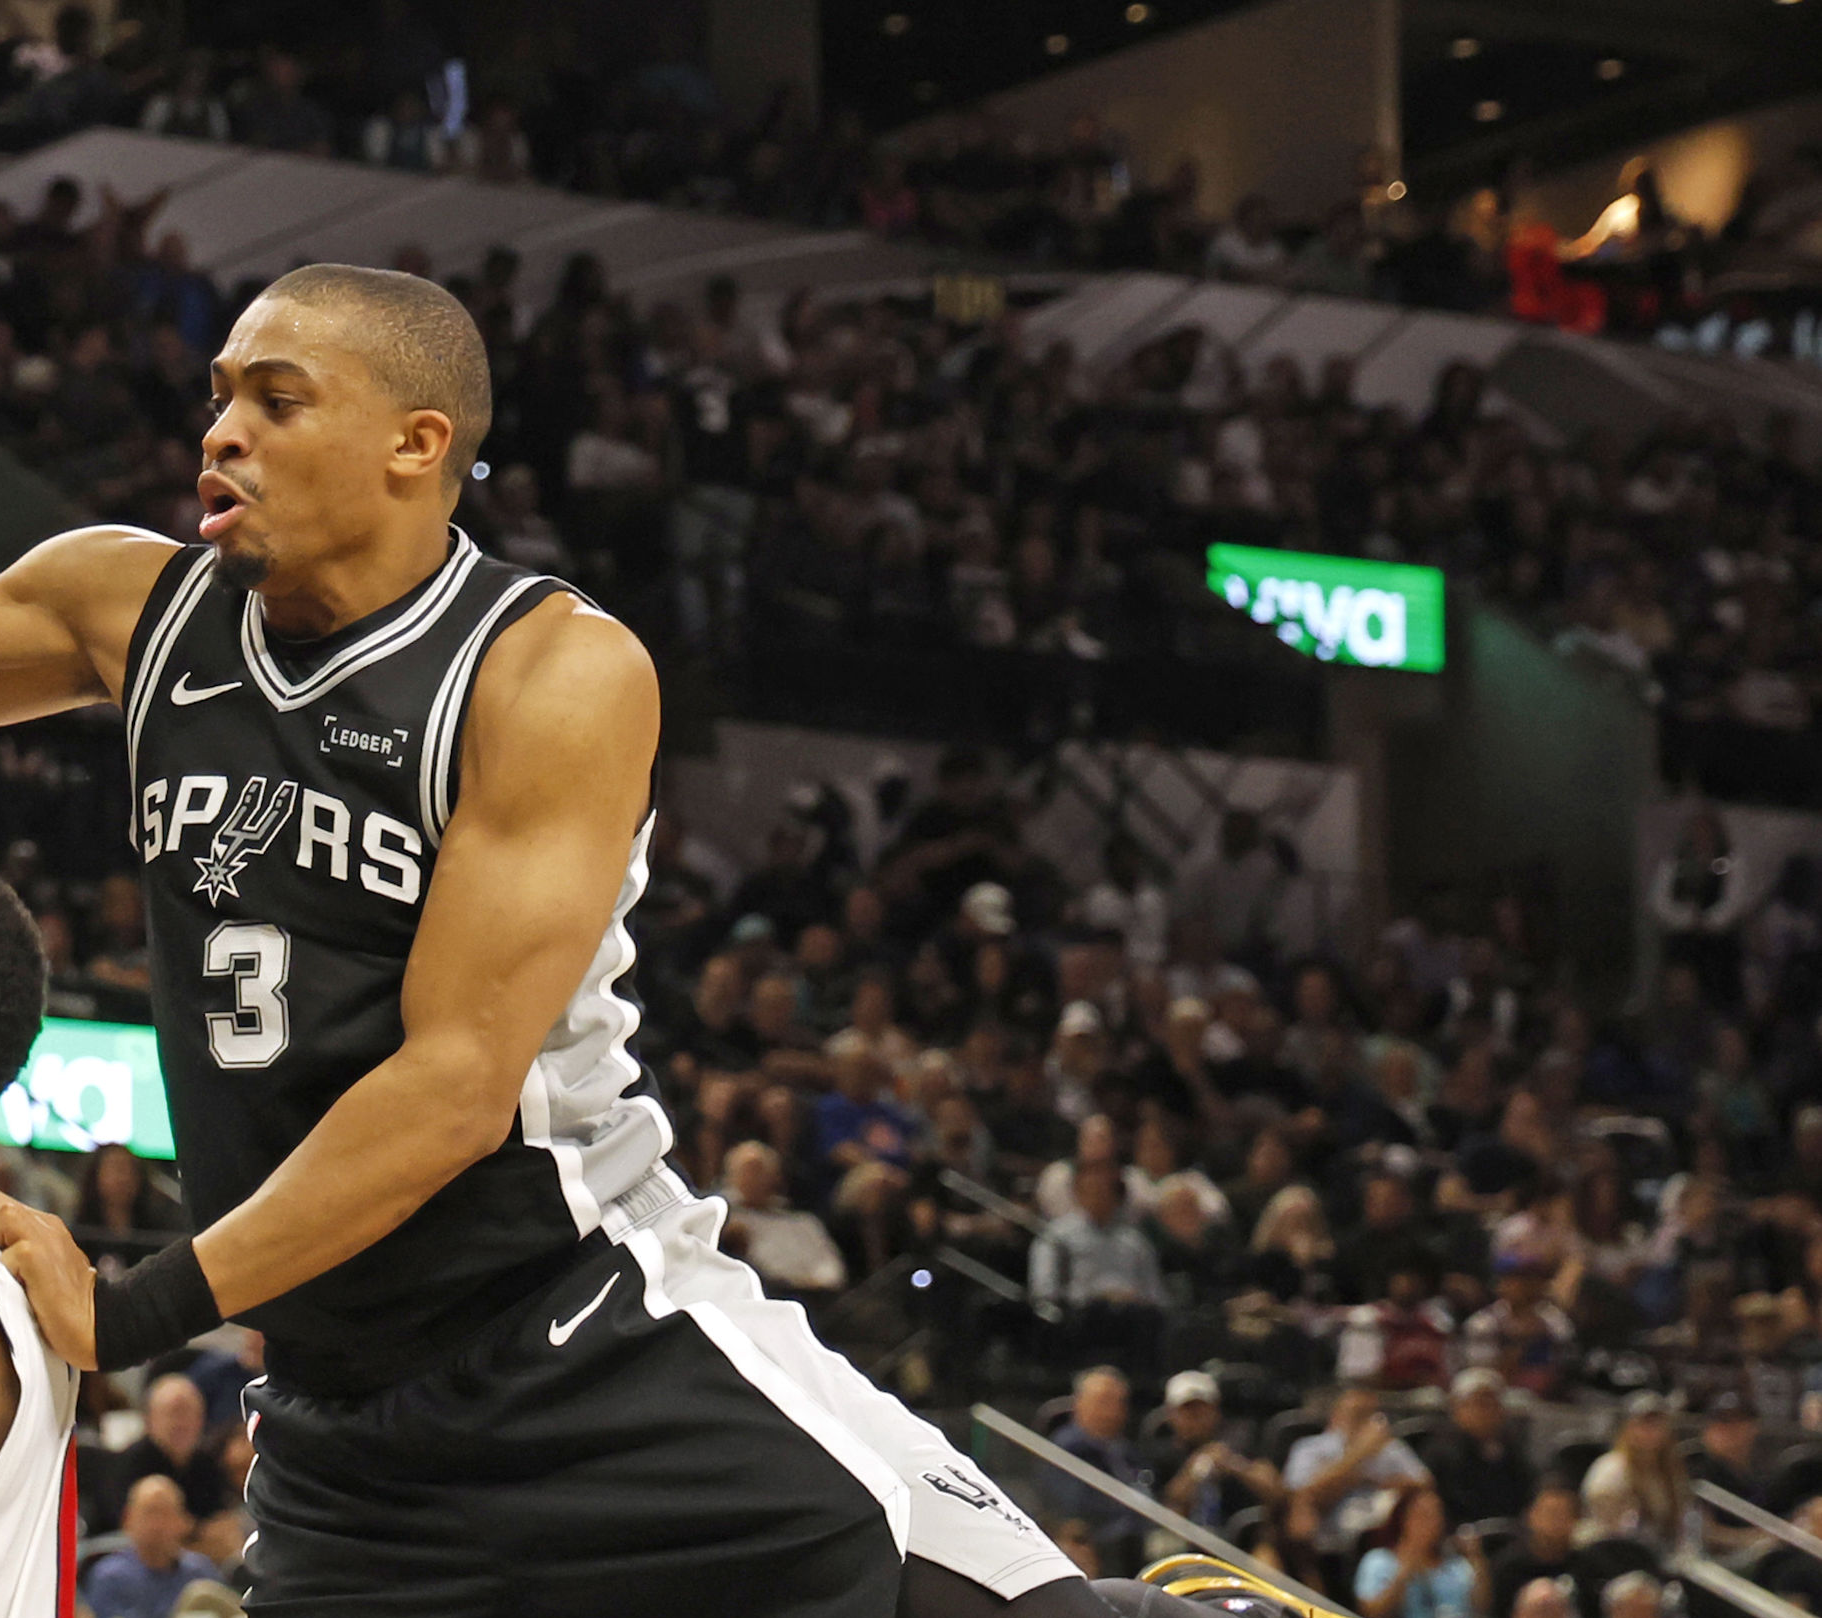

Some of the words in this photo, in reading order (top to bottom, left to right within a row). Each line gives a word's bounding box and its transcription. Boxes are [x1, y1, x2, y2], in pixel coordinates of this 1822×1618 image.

[330, 727, 393, 755] LEDGER
[142, 775, 423, 908] SPURS
[203, 919, 291, 1069] 3
